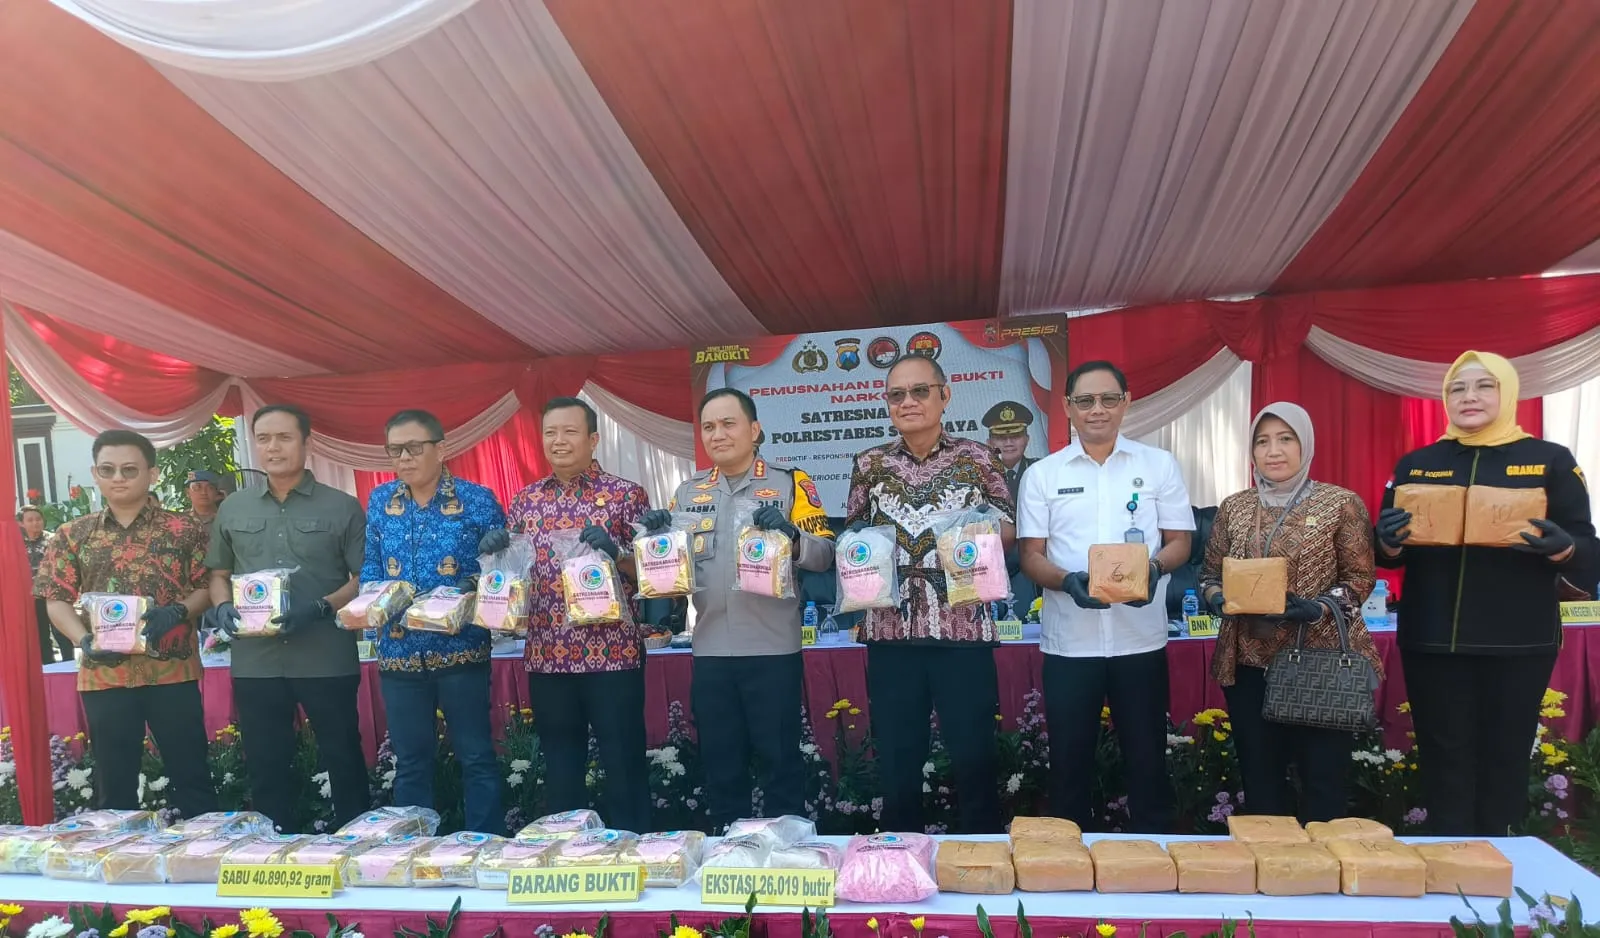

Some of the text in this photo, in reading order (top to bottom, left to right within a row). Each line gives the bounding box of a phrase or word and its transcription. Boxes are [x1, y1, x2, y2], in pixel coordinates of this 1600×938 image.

[1001, 325, 1058, 338] PRESISI
[696, 348, 750, 363] BANGKIT
[749, 380, 869, 397] PEMUSNAHAN
[950, 371, 1004, 382] BUKTI
[801, 407, 890, 424] SATRESNA
[772, 426, 884, 444] POLRESTABES
[1506, 465, 1546, 476] GRANAT
[1192, 620, 1208, 631] BNN
[222, 870, 331, 889] SABU 40.890,92 gram
[511, 872, 636, 894] BARANG BUKTI
[705, 873, 831, 897] EKSTASI 26.019 butir
